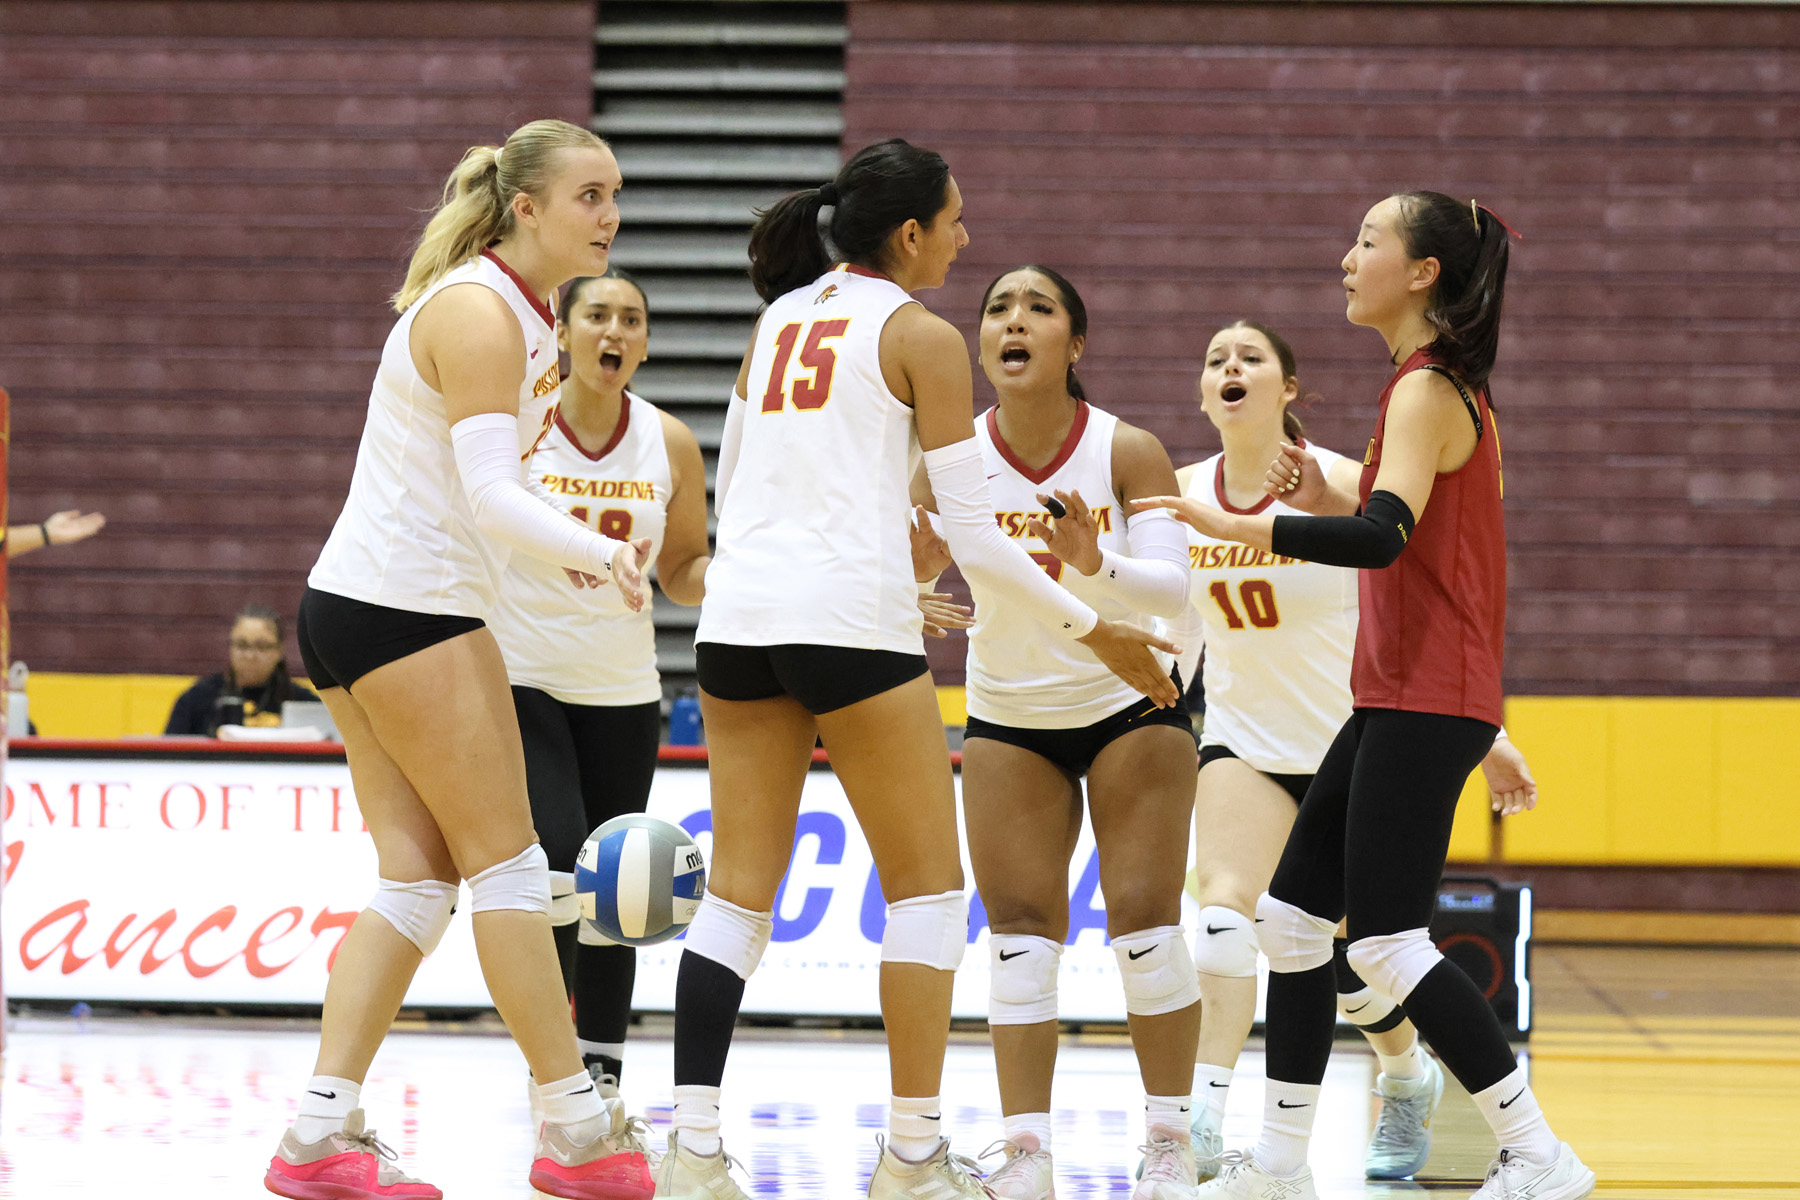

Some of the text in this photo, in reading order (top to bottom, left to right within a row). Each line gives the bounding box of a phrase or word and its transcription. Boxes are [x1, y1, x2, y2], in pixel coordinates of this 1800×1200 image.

[761, 317, 852, 415] 15
[540, 473, 655, 501] PASADENA
[1208, 577, 1281, 630] 10
[159, 781, 254, 831] OF
